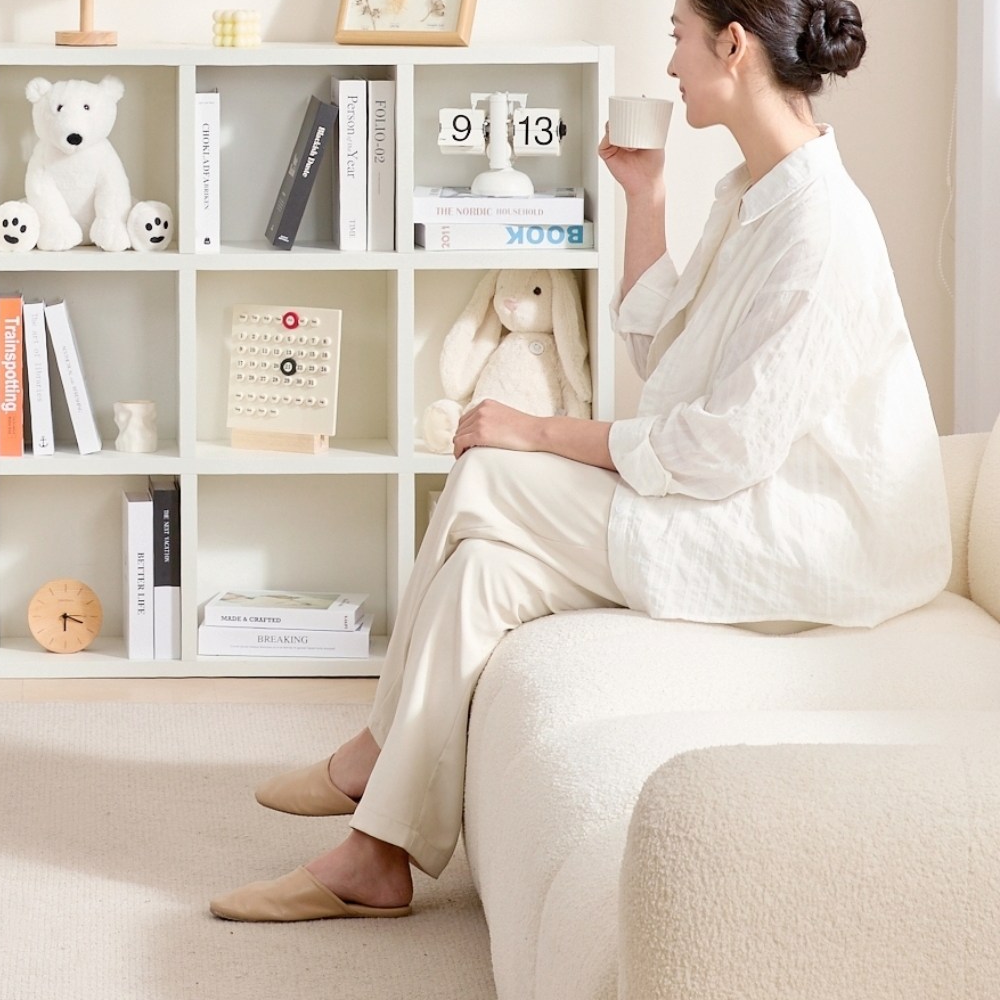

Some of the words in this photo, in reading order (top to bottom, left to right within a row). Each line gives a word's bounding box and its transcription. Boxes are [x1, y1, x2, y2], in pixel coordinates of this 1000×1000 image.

[347, 95, 358, 135] Person
[452, 114, 472, 142] 9
[374, 99, 387, 164] FOLIO-02
[518, 116, 553, 146] 13
[346, 150, 358, 179] Year
[436, 207, 452, 216] THE
[456, 207, 492, 216] NORDIC
[496, 208, 544, 216] HOUSEHOLD
[441, 225, 450, 248] 2011
[506, 225, 584, 244] BOOK
[1, 316, 20, 413] Trainspotting
[137, 552, 145, 590] BETTER
[137, 593, 145, 616] LIFE
[257, 635, 308, 644] BREAKING
